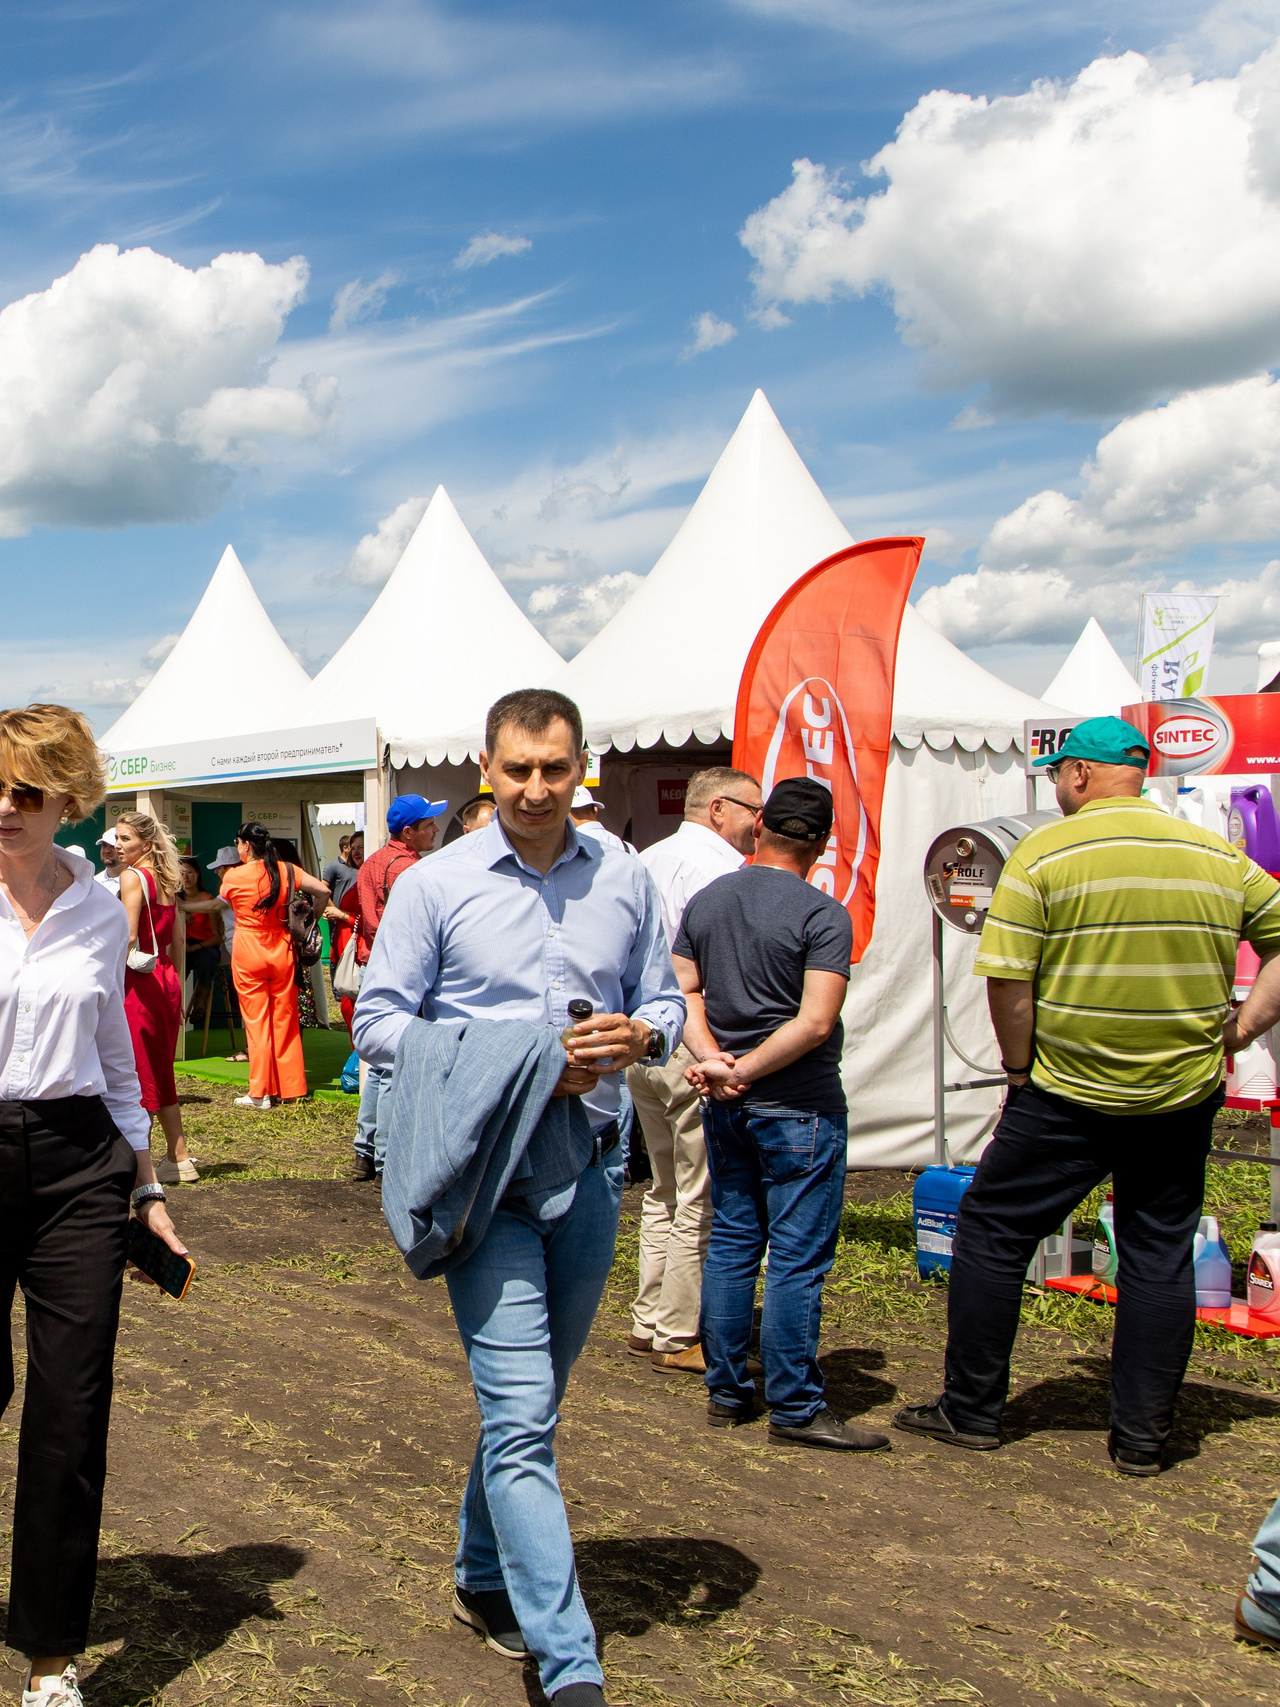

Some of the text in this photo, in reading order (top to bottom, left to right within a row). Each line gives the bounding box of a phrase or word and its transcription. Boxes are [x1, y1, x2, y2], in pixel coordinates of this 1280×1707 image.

[1160, 660, 1180, 700] АЯ
[1156, 729, 1214, 744] SINTEC
[120, 756, 176, 776] СБЕР Бизнес
[211, 756, 216, 767] С
[217, 757, 231, 766] нами
[232, 752, 255, 764] каждый
[257, 749, 279, 762] второй
[958, 868, 986, 878] ROLF
